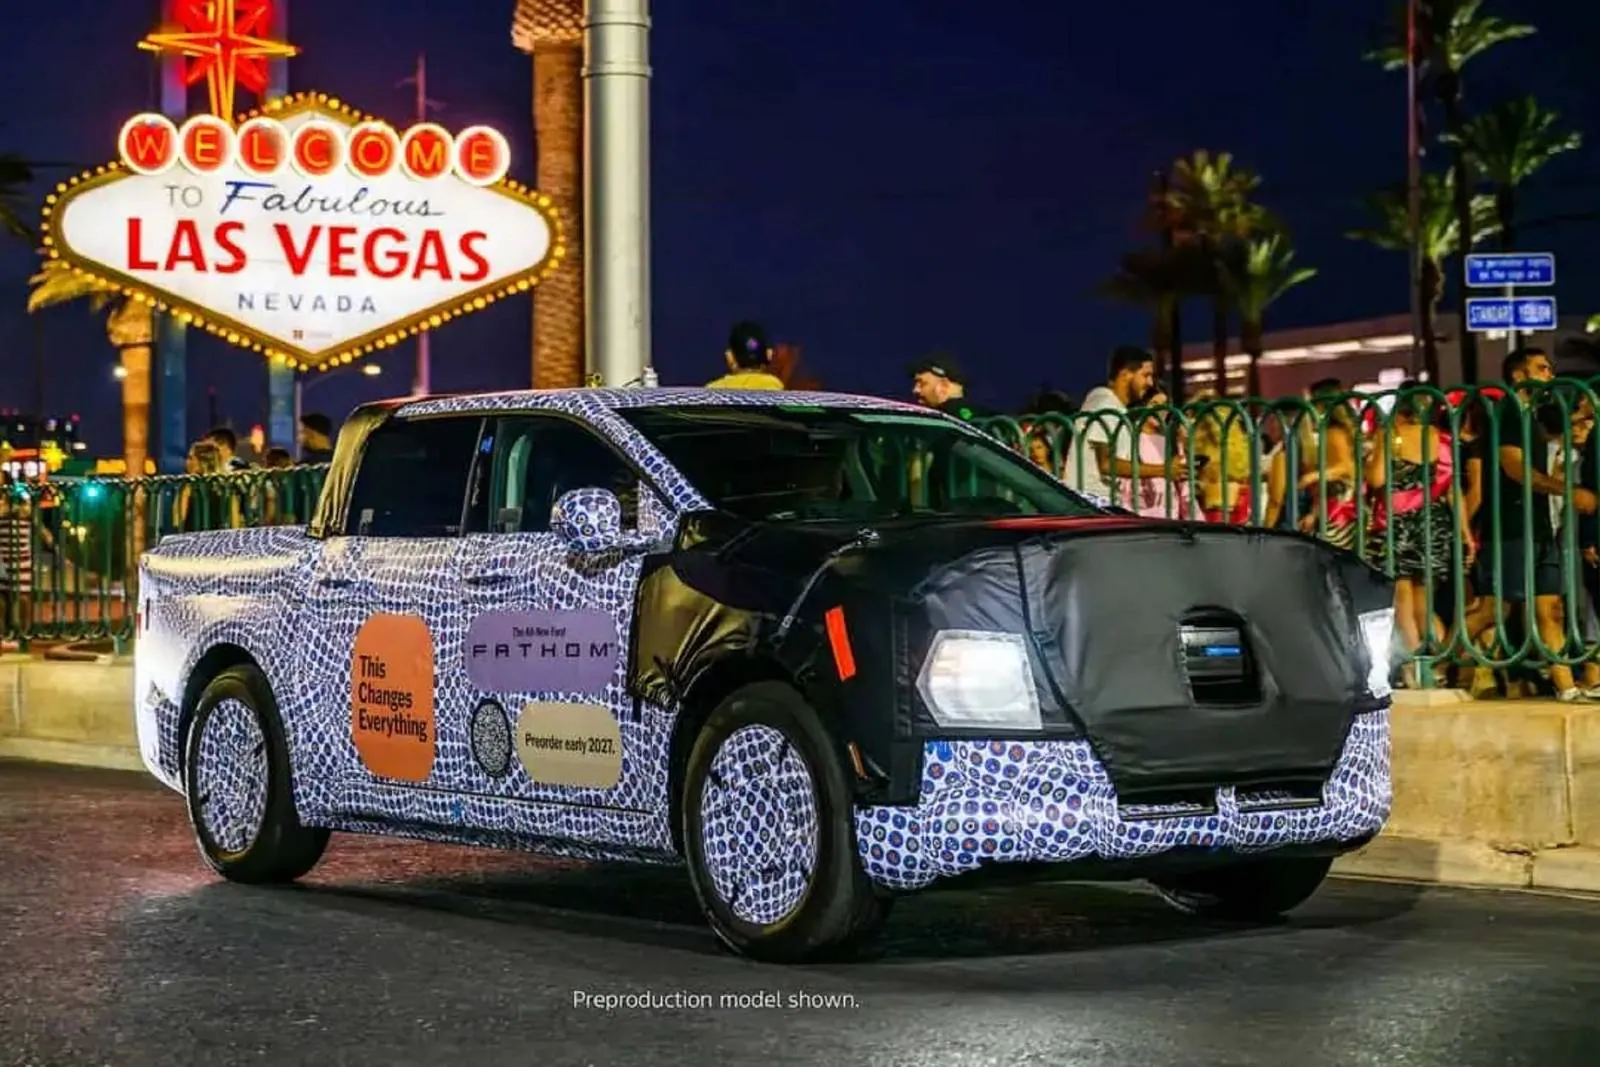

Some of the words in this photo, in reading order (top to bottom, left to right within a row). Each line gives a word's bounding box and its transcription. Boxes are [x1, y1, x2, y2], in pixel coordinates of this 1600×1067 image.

[130, 125, 495, 173] WELCOME
[165, 184, 203, 208] TO
[219, 180, 445, 217] Fabulous
[127, 217, 247, 274] LAS
[273, 223, 490, 282] VEGAS
[237, 292, 377, 314] NEVADA
[359, 655, 386, 678] This
[359, 681, 413, 712] Changes
[359, 707, 428, 743] Everything
[525, 732, 563, 750] Preorder
[564, 736, 587, 755] early
[588, 737, 616, 754] 2027.
